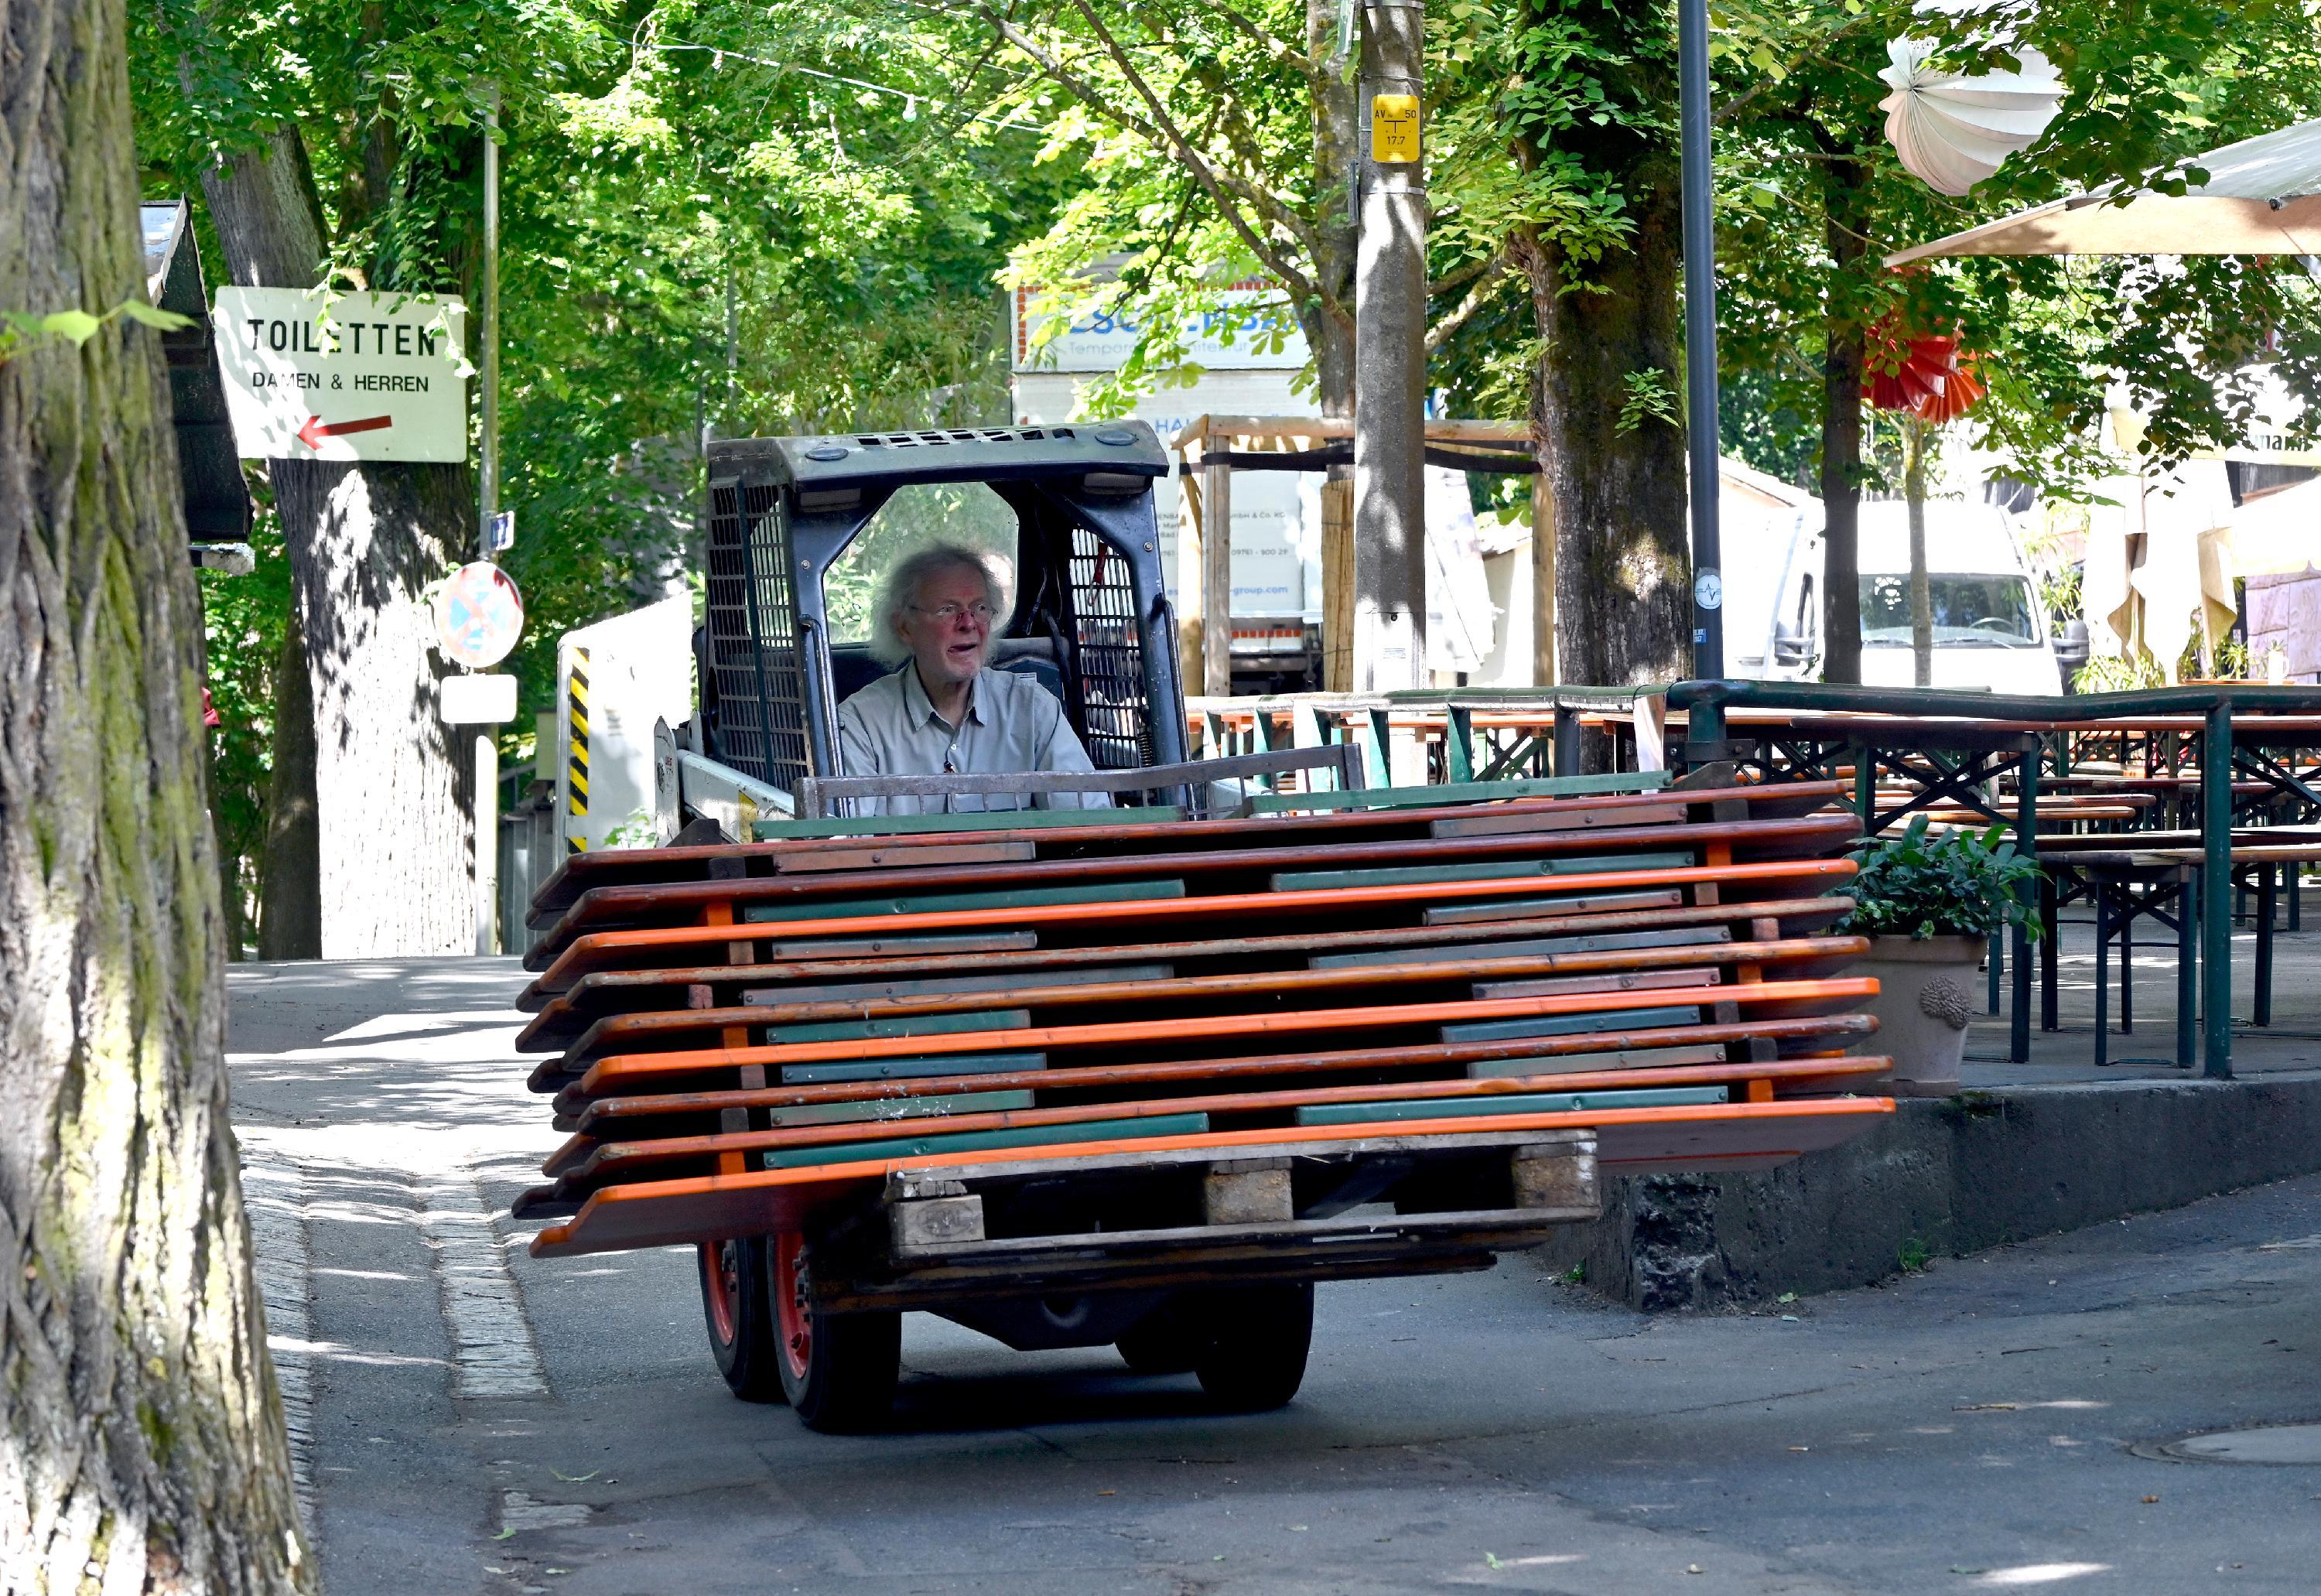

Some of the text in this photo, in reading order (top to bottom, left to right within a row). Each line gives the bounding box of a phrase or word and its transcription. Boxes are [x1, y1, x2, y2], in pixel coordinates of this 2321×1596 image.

[1375, 110, 1386, 118] AV
[1405, 110, 1417, 118] 50
[1386, 136, 1406, 145] 17.7
[252, 372, 429, 392] DAMEN & HERREN
